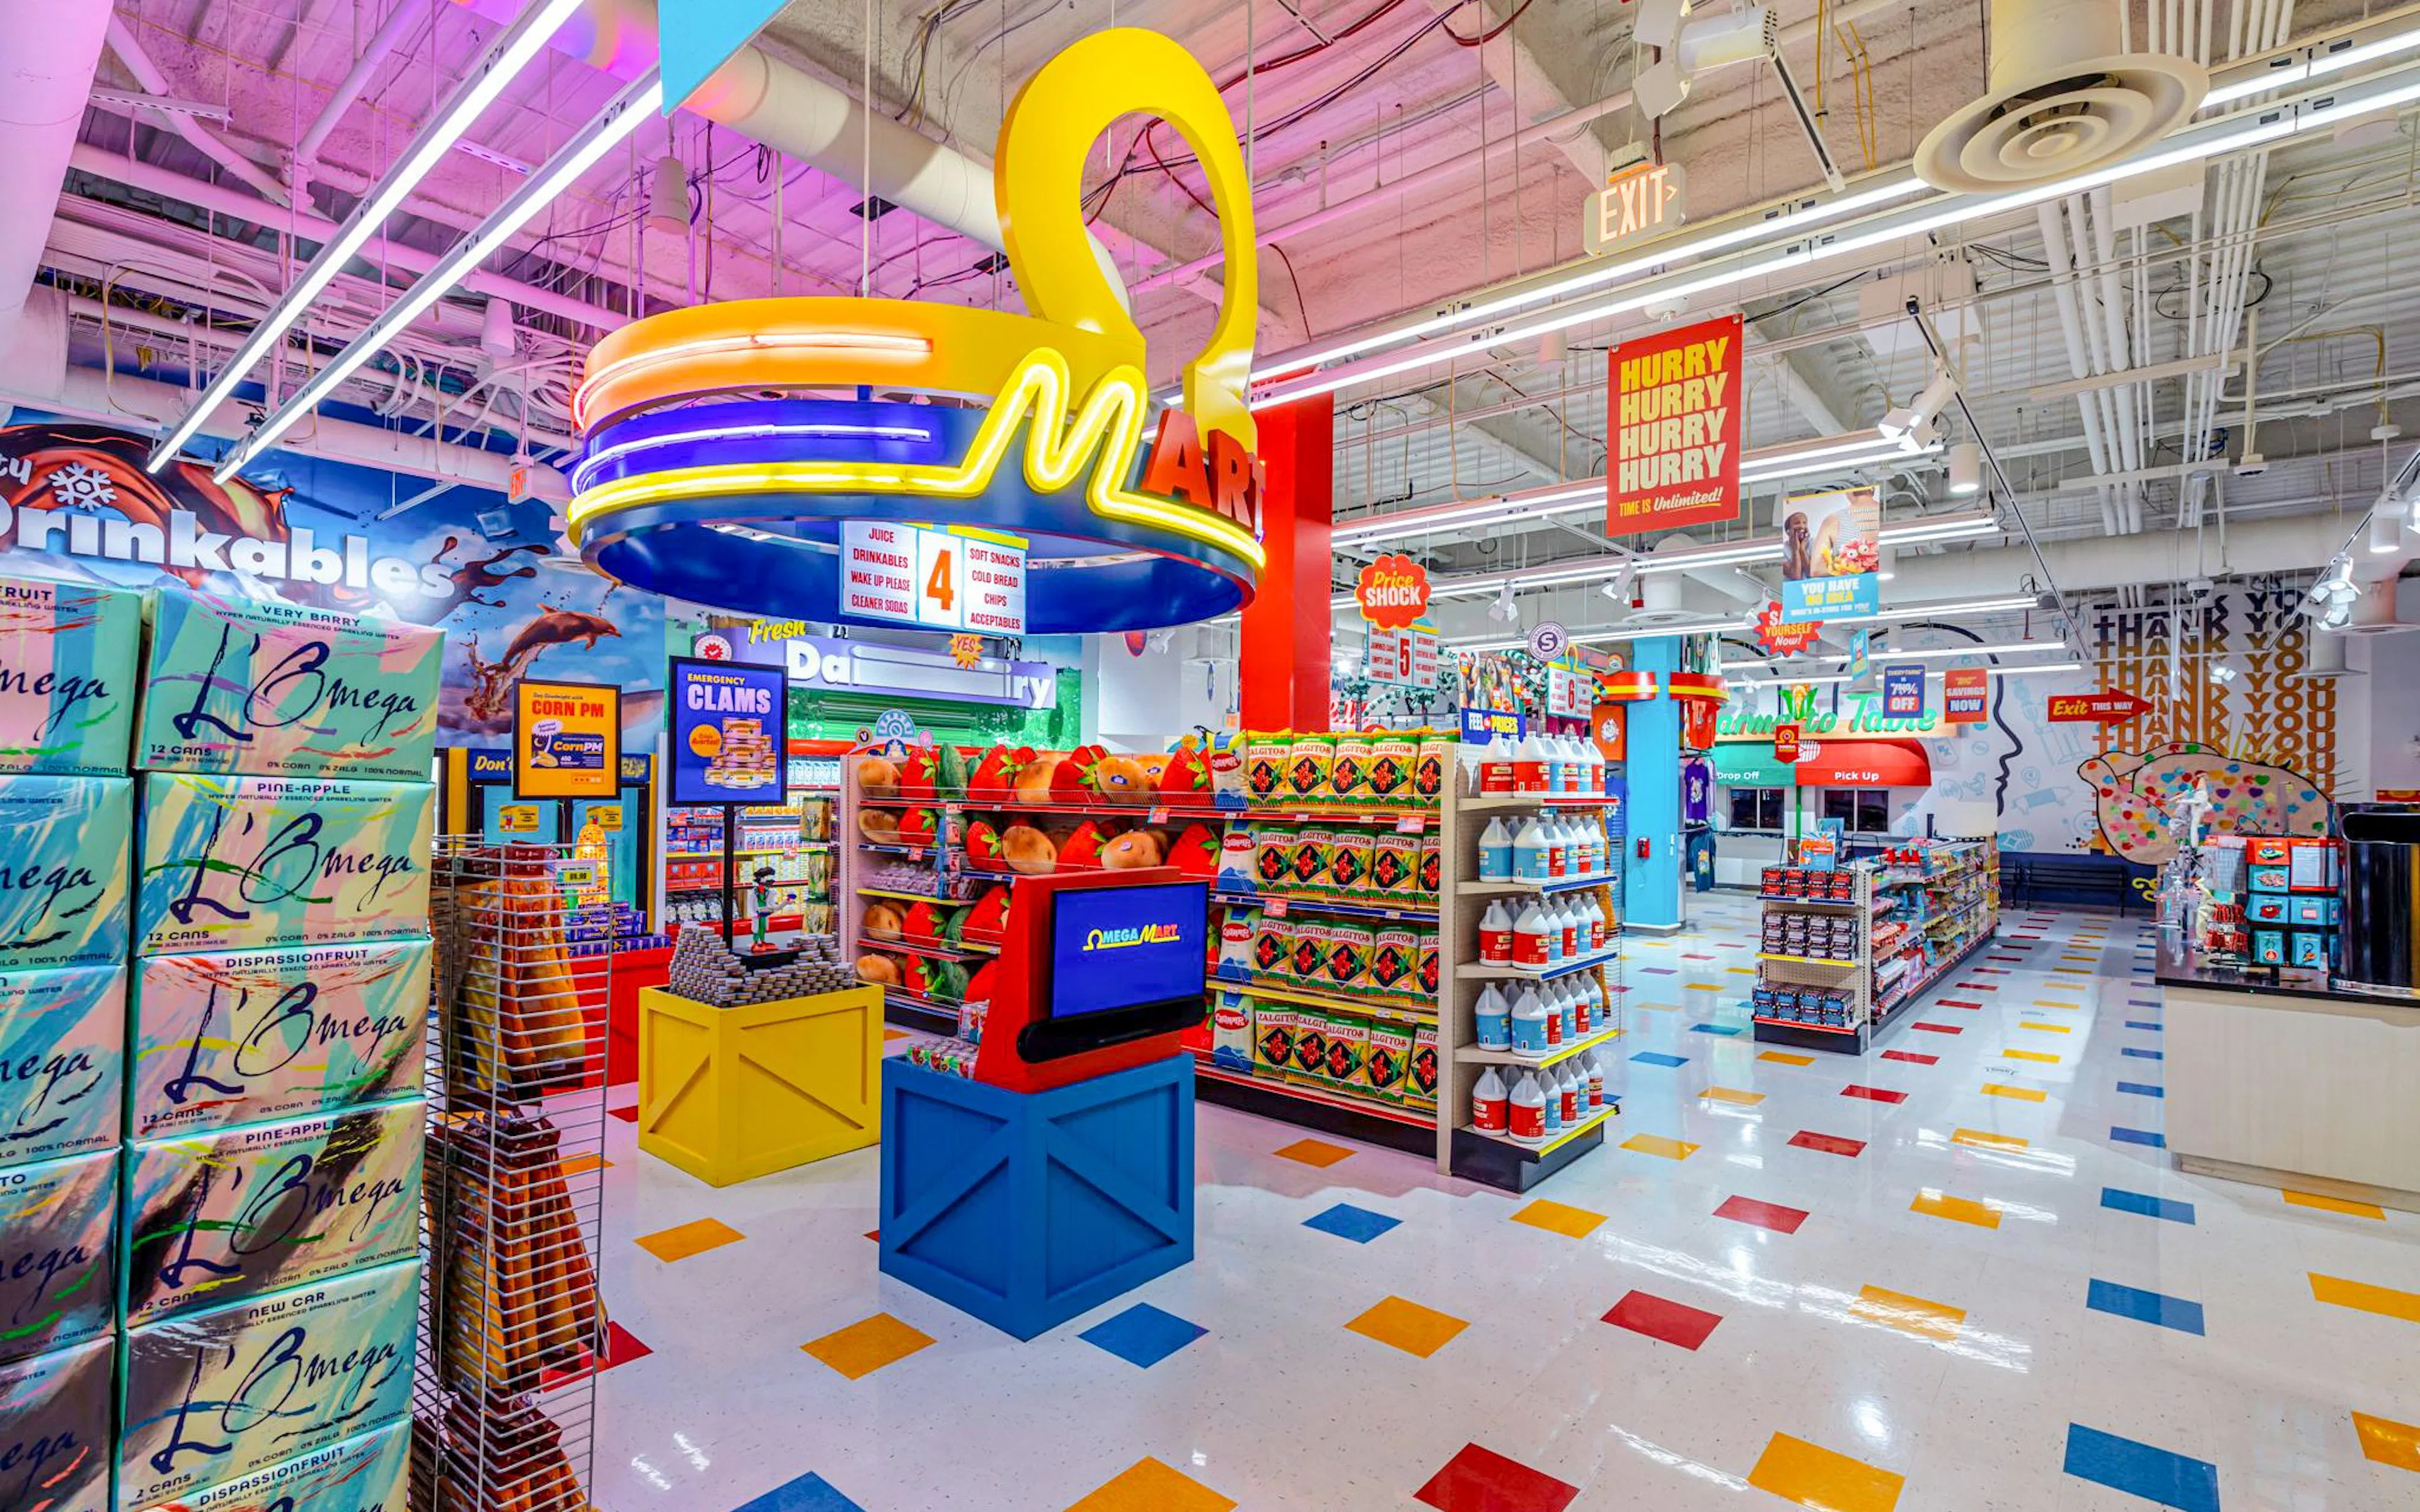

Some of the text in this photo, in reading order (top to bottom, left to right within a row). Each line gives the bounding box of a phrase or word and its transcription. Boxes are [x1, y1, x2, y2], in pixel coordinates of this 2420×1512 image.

[1599, 167, 1668, 243] EXIT
[1620, 336, 1729, 393] HURRY
[1620, 372, 1729, 427] HURRY
[971, 347, 1265, 530] MAR
[1620, 407, 1728, 459] HURRY
[1619, 442, 1727, 494] HURRY
[1618, 486, 1724, 517] TIME IS Unlimited!
[868, 528, 894, 543] JUICE
[0, 495, 456, 600] rinkables
[853, 548, 908, 568] DRINKABLES
[970, 547, 1020, 568] SOFT SNACKS
[851, 570, 910, 592] WAKE UP PLEASE
[926, 549, 954, 610] 4
[972, 570, 1018, 588] COLD BREAD
[1373, 570, 1414, 588] Price
[1801, 578, 1860, 595] YOU HAVE
[0, 586, 52, 600] RUIT
[984, 592, 1007, 607] CHIPS
[1365, 585, 1422, 607] SHOCK
[851, 594, 908, 614] CLEANER SODAS
[245, 615, 290, 626] NATURALLY
[292, 621, 331, 631] ESSENCED
[262, 605, 361, 627] VERY BARRY
[970, 612, 1021, 630] ACCEPTABLES
[1765, 622, 1813, 637] YOURSELF
[956, 635, 977, 653] YES
[1541, 634, 1555, 650] S
[1774, 634, 1803, 647] Now!
[1400, 638, 1410, 677] 5
[687, 672, 746, 685] EMERGENCY
[687, 684, 771, 714] CLAMS
[1568, 679, 1574, 709] 6
[1946, 687, 1986, 696] SAVINGS
[532, 700, 604, 718] CORN PM
[1806, 707, 1838, 733] to
[1846, 692, 1938, 733] Tae
[1891, 698, 1915, 711] OFF
[1949, 699, 1982, 712] NOW
[2052, 699, 2134, 716] Exit THIS WAY
[1468, 711, 1485, 732] FEEL
[1491, 714, 1519, 734] PRICES
[150, 743, 212, 757] 12 CANS
[553, 741, 604, 752] CornPM
[282, 762, 311, 770] CORN
[1717, 770, 1760, 781] Drop Off
[1834, 770, 1880, 782] Pick Up
[256, 782, 350, 795] PINE-APPLE
[148, 930, 210, 942] 12 CANS
[1139, 923, 1178, 944] MART
[29, 956, 57, 965] 100%
[225, 949, 369, 969] DISPASSIONFRUIT
[245, 1121, 333, 1144] PINE-APPL
[56, 1135, 110, 1150] NORMAL
[248, 1291, 325, 1320] NEW CAR
[149, 1474, 192, 1494] CANS
[199, 1446, 345, 1506] DISPASSIONFRUIT
